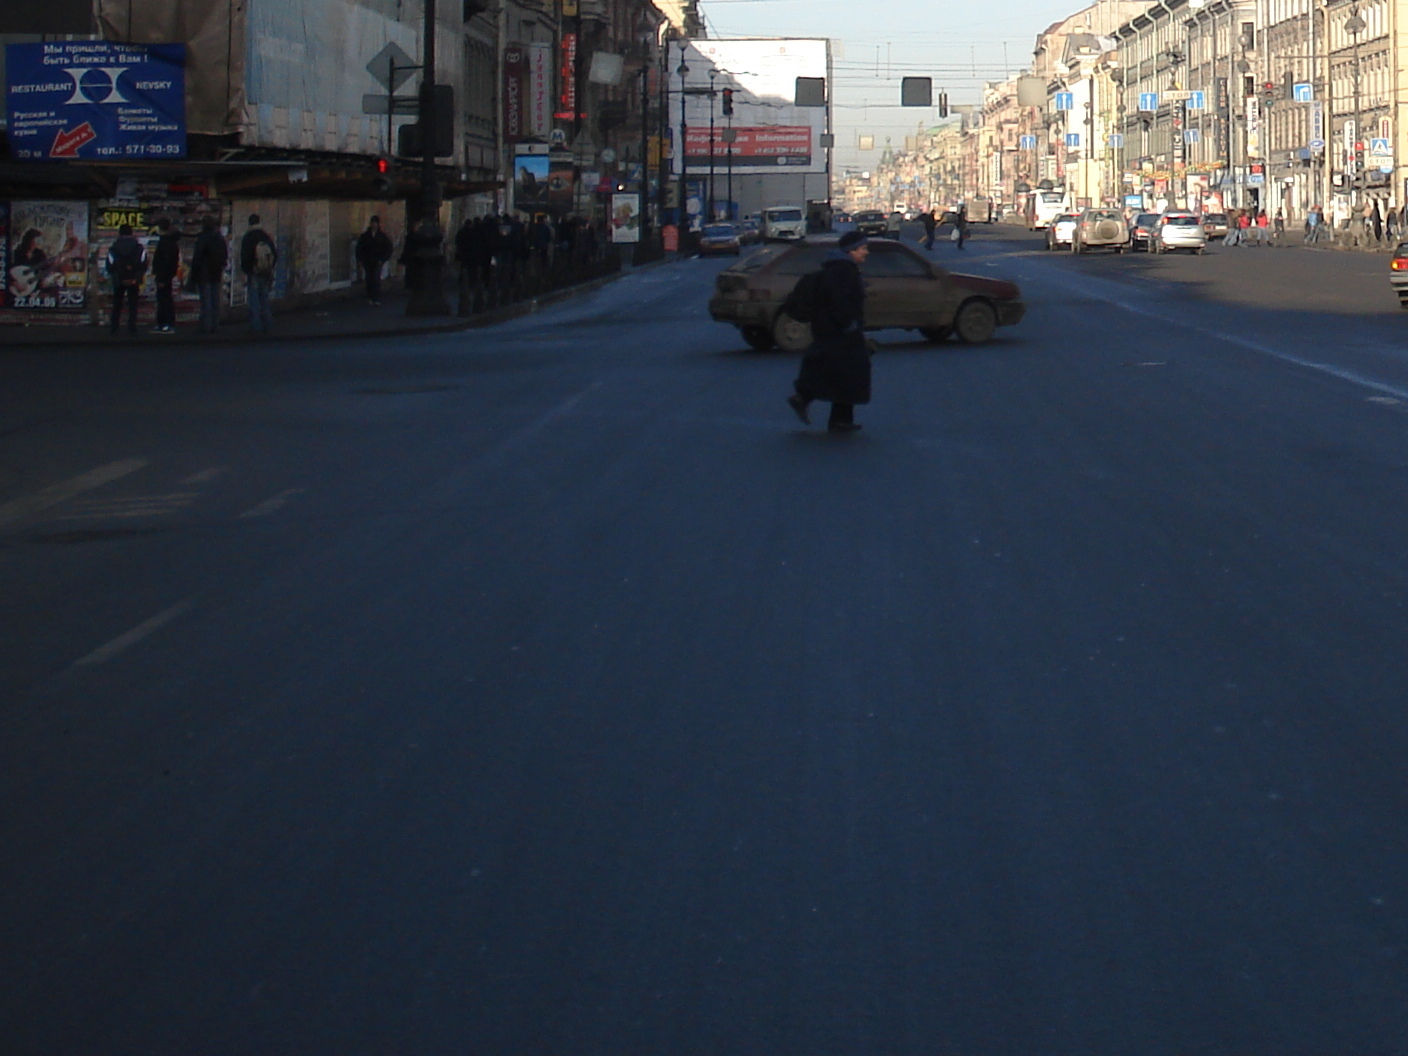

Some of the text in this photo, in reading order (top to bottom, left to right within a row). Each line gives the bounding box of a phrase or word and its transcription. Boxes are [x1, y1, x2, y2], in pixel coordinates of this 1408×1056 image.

[44, 45, 62, 54] Мы
[43, 55, 70, 65] быть
[119, 54, 141, 63] Вам
[11, 81, 172, 93] RESTAURANT NEVSKY
[755, 134, 808, 142] Information
[102, 211, 144, 226] SPACE
